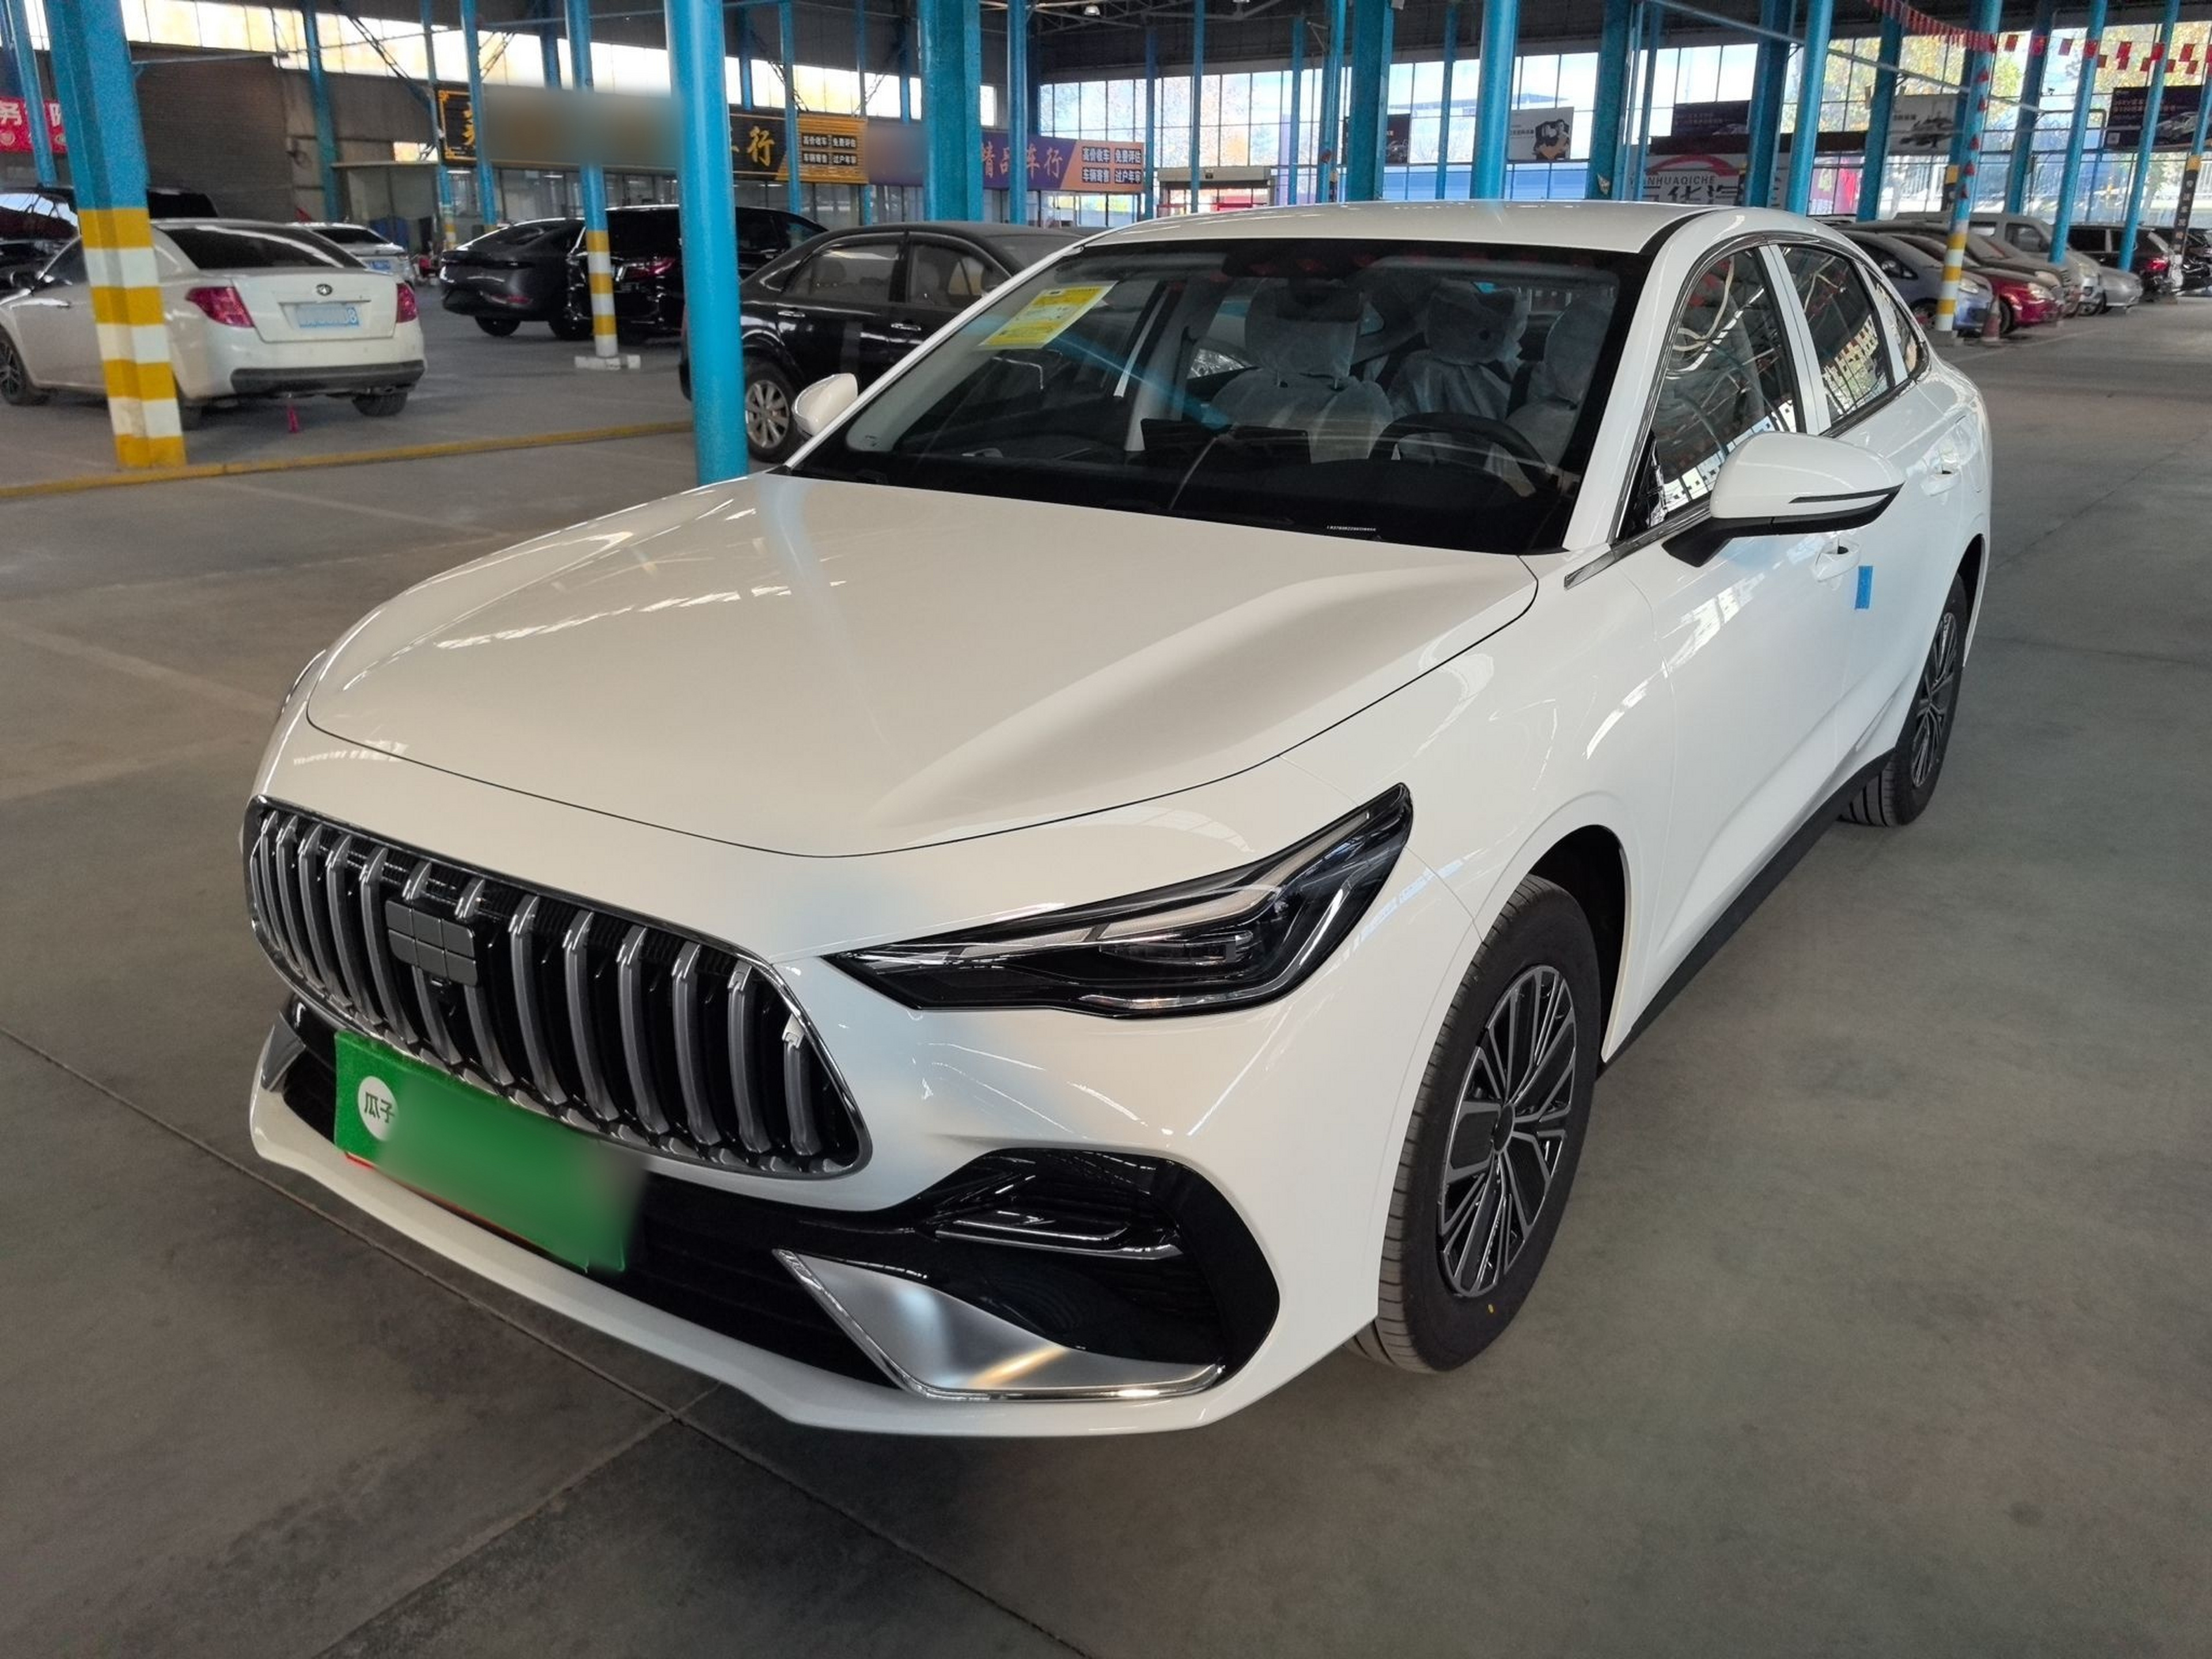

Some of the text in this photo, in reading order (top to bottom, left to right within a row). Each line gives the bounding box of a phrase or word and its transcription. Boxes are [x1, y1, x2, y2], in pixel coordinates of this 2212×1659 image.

[732, 126, 775, 166] 行
[1082, 147, 1141, 164] 高价收车 免费评估
[1082, 167, 1141, 183] 车辆寄售 过户年审
[365, 1092, 395, 1123] 瓜子
